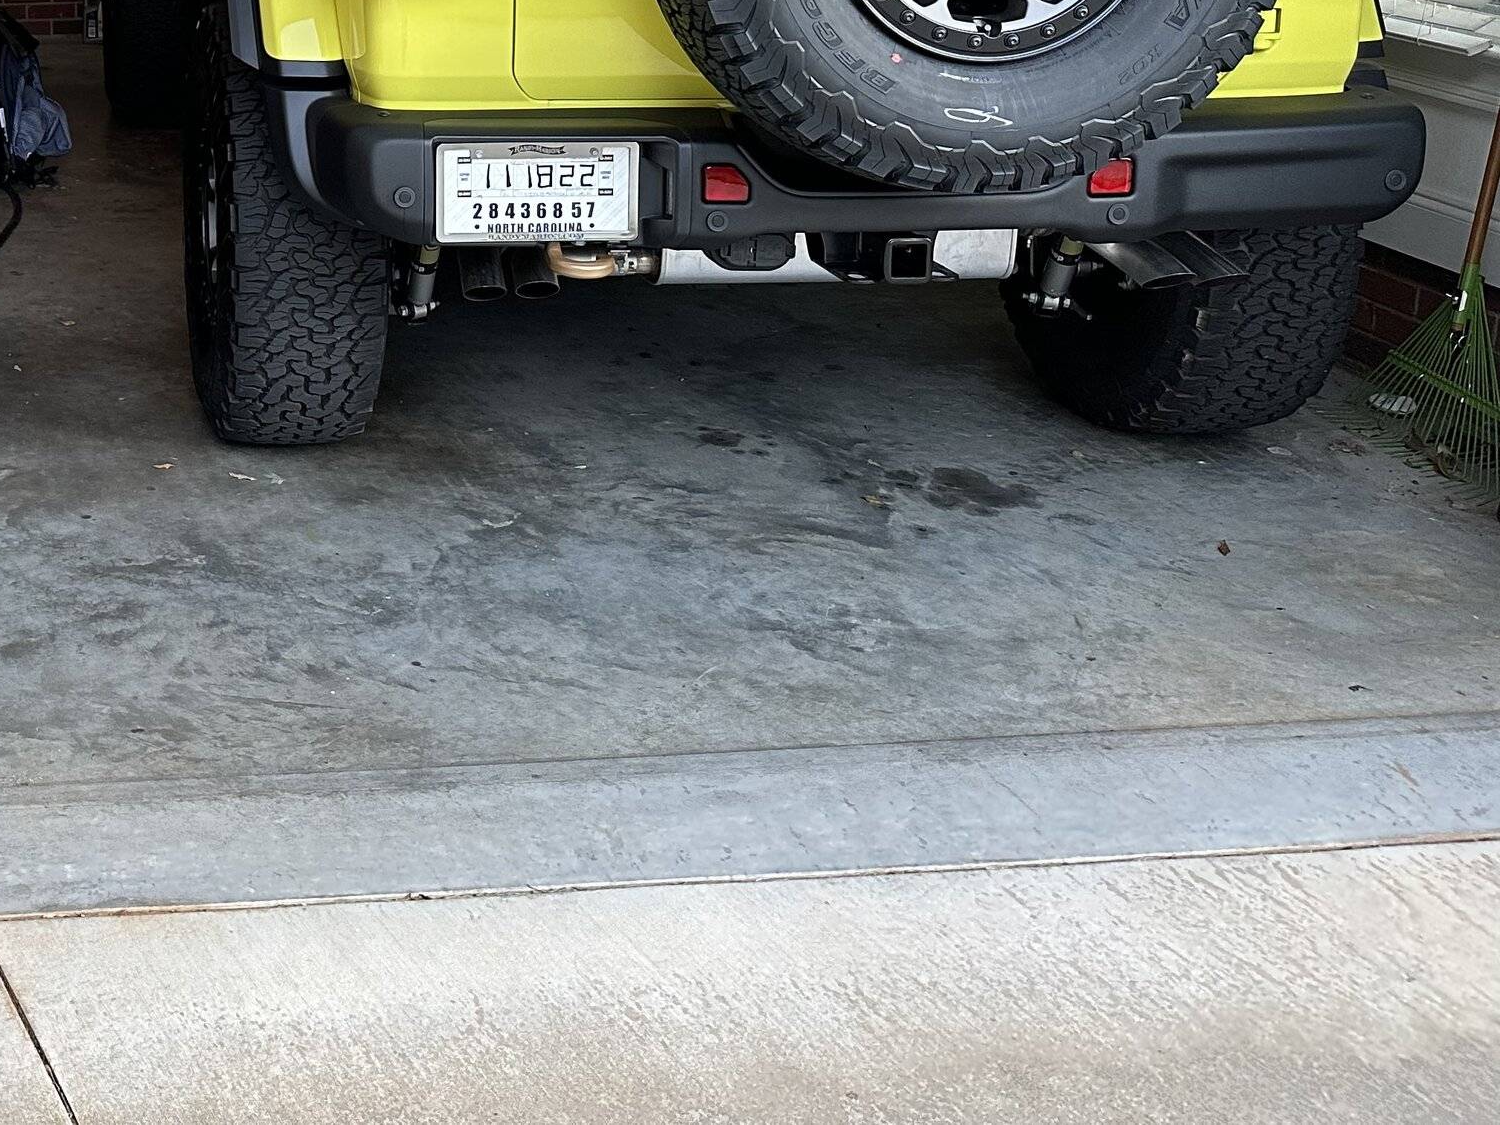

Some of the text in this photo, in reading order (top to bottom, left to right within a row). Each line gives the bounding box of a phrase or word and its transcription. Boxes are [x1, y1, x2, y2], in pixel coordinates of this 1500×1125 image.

[473, 201, 595, 219] 28436857
[487, 222, 583, 233] NORTH CAROLINA
